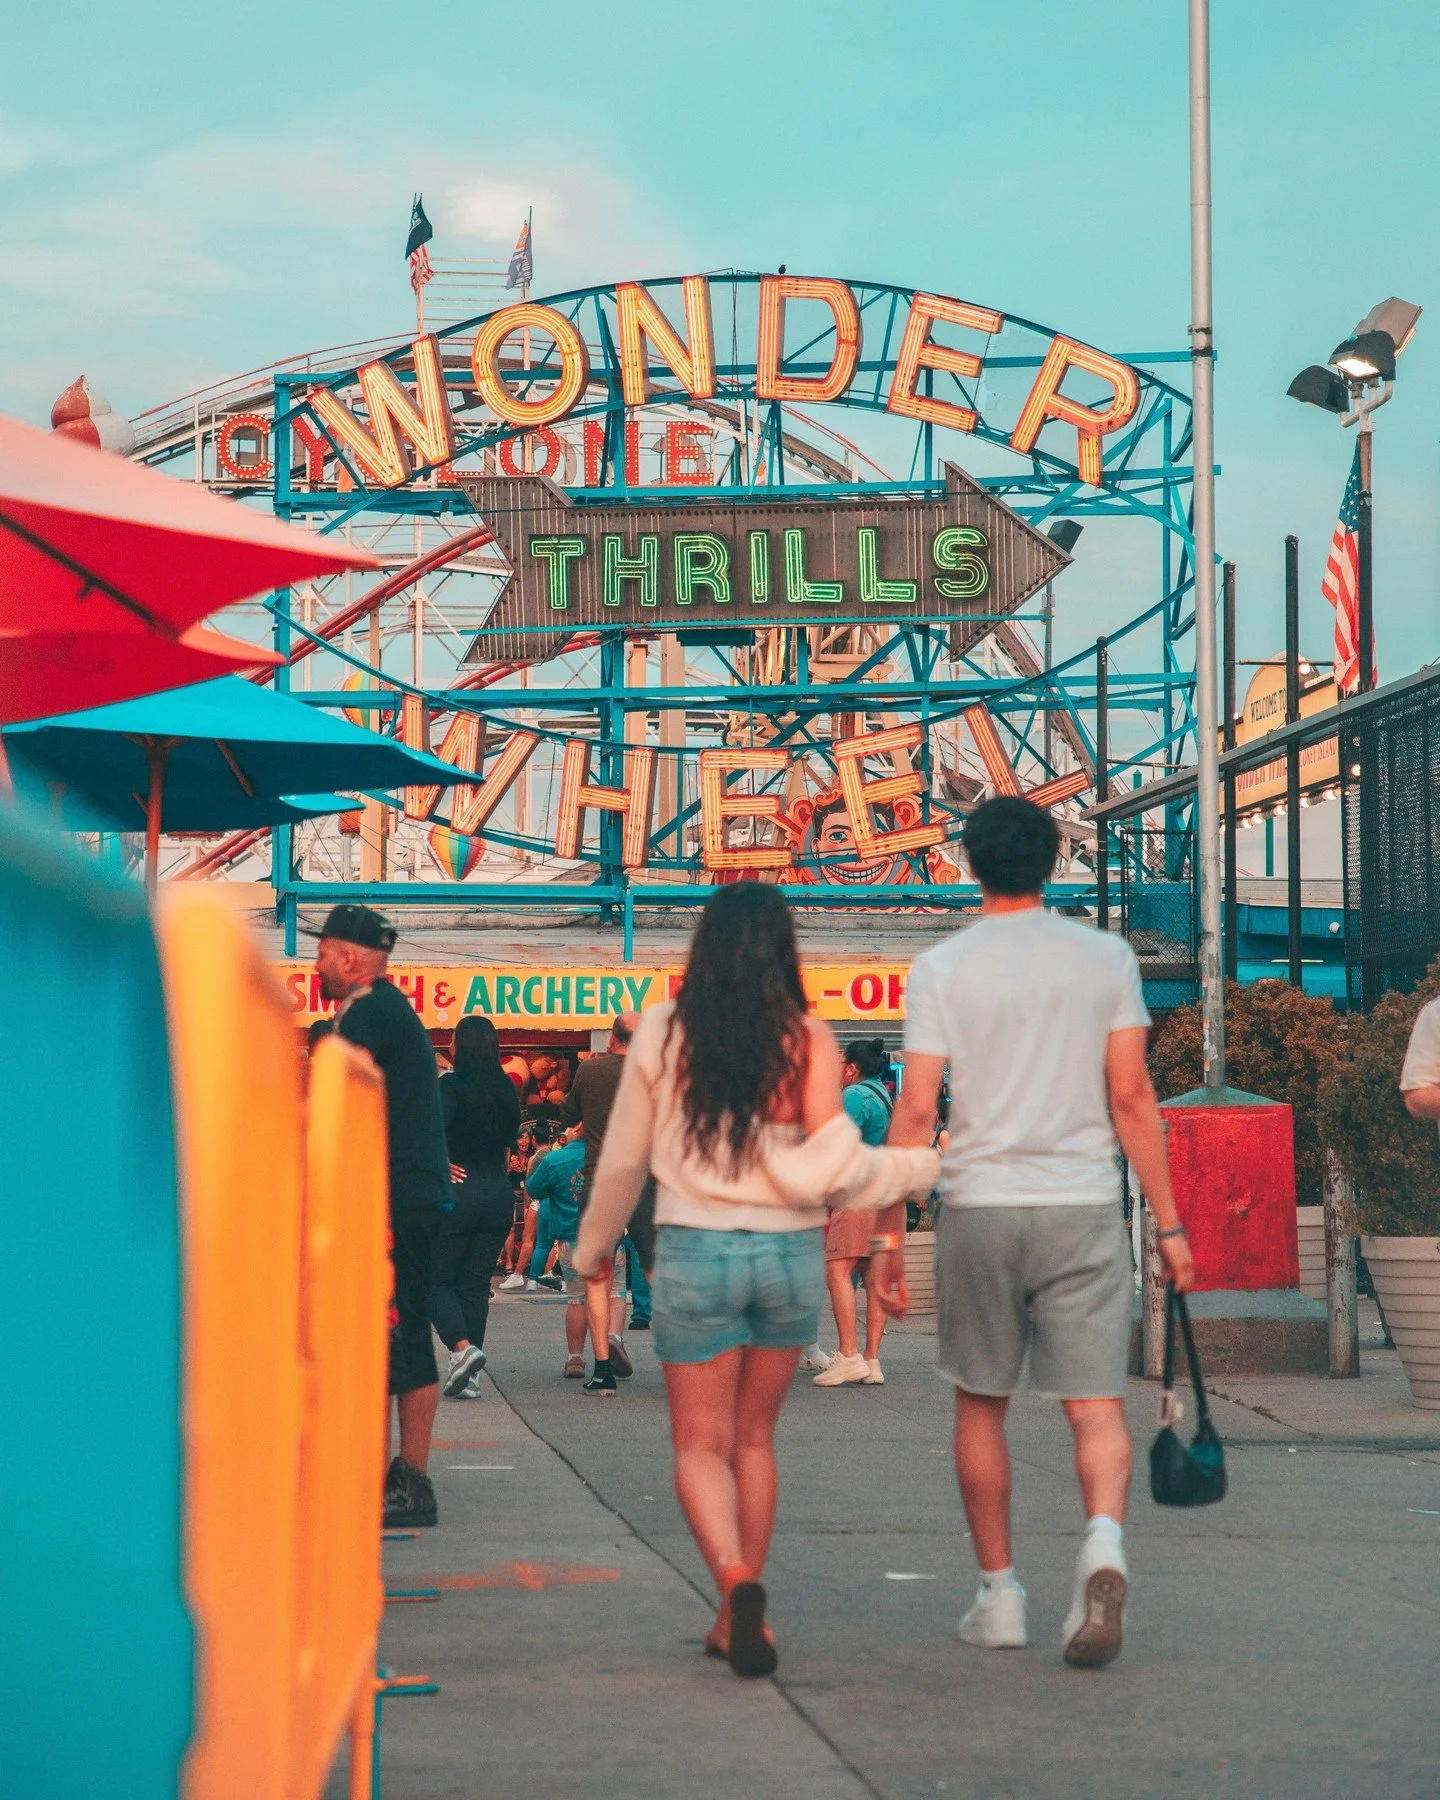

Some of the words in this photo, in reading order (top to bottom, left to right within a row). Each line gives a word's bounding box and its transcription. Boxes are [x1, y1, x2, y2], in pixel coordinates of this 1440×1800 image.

[306, 275, 1141, 488] WONDER
[530, 526, 991, 610] THRILLS
[402, 692, 1093, 871] WHEEL
[286, 973, 424, 1013] SMH
[463, 975, 653, 1016] ARCHERY
